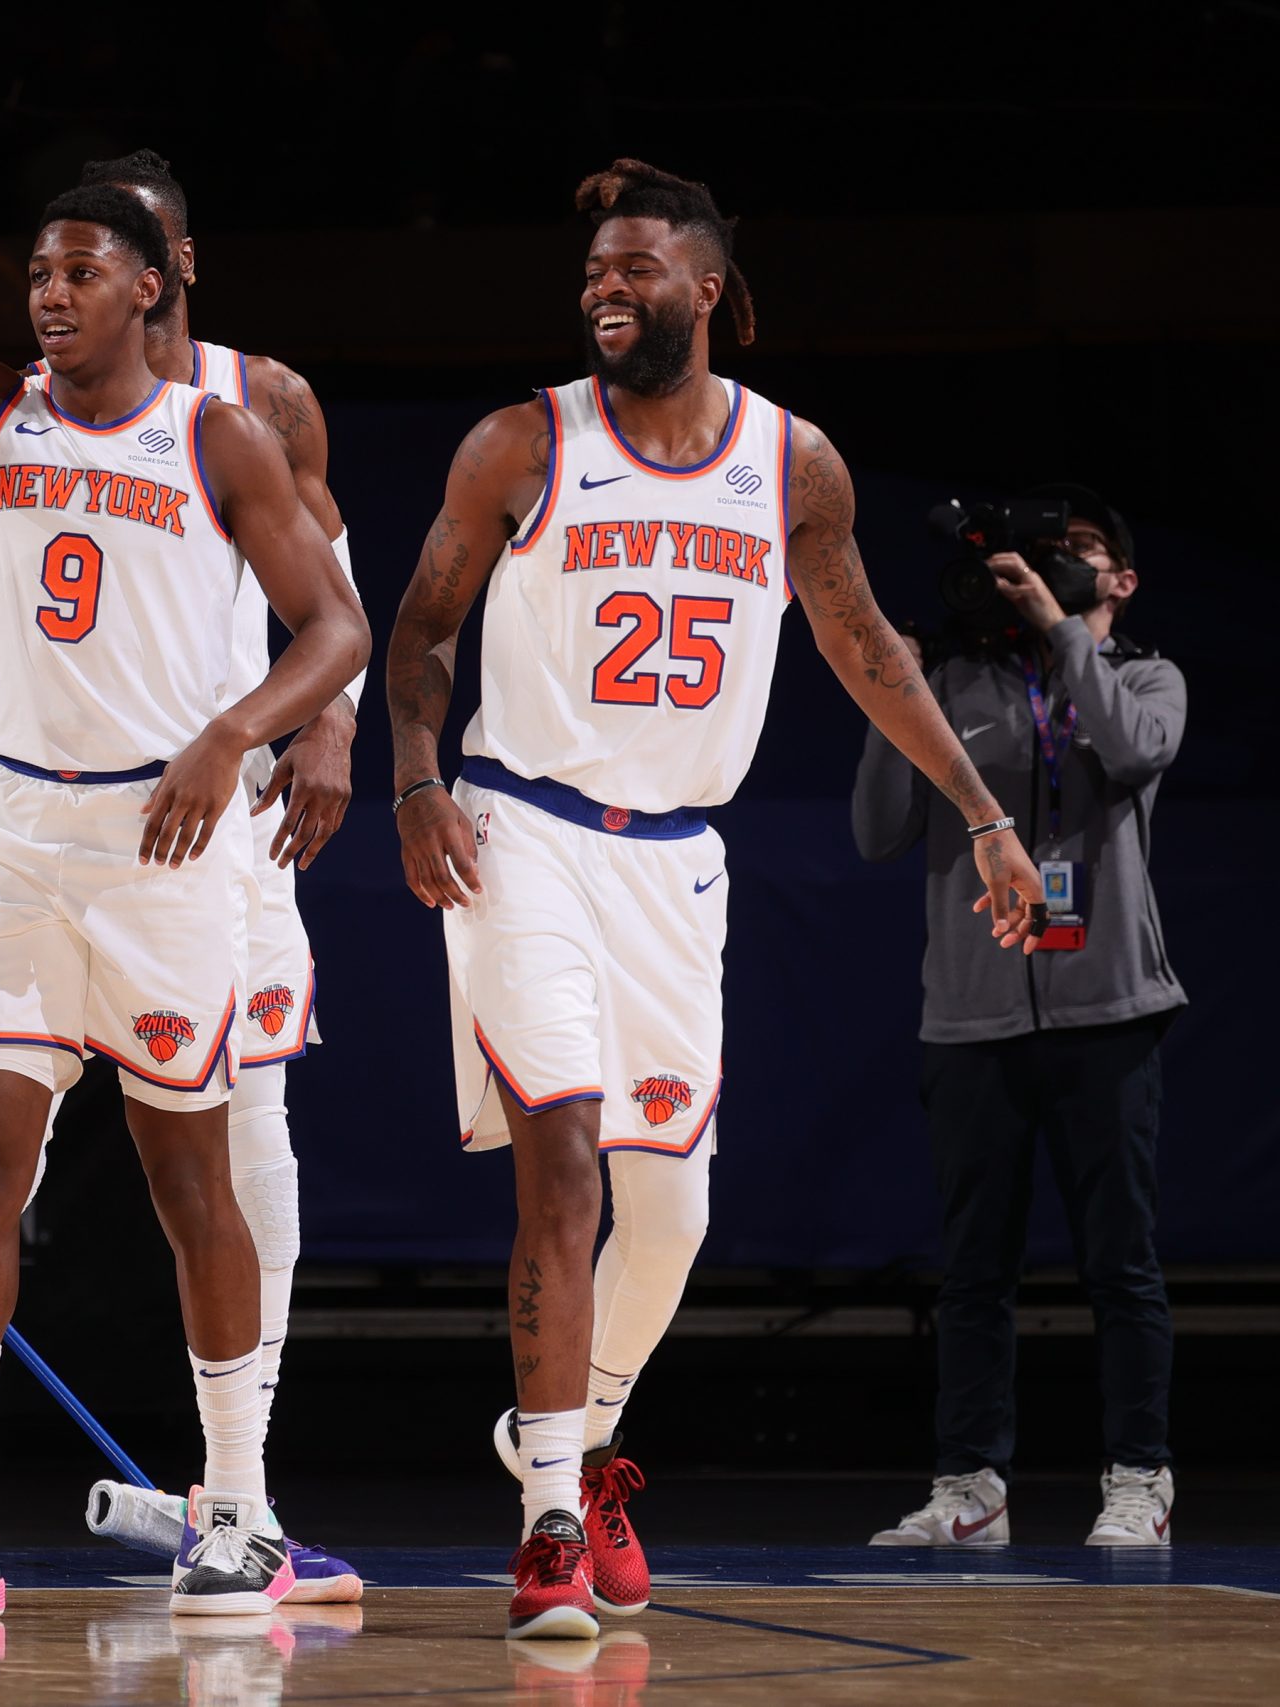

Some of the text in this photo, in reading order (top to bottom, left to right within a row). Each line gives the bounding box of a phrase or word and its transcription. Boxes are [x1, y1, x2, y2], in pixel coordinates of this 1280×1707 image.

[127, 455, 180, 467] SQUARESPACE
[86, 468, 189, 539] YORK
[716, 497, 768, 510] SQUARESPACE
[563, 520, 771, 588] NEW YORK
[35, 531, 104, 644] 9
[591, 591, 734, 710] 25
[248, 986, 294, 1014] KNICKS
[133, 1013, 195, 1041] KNICKS
[631, 1077, 691, 1108] KNICKS
[214, 1503, 236, 1511] PUMA
